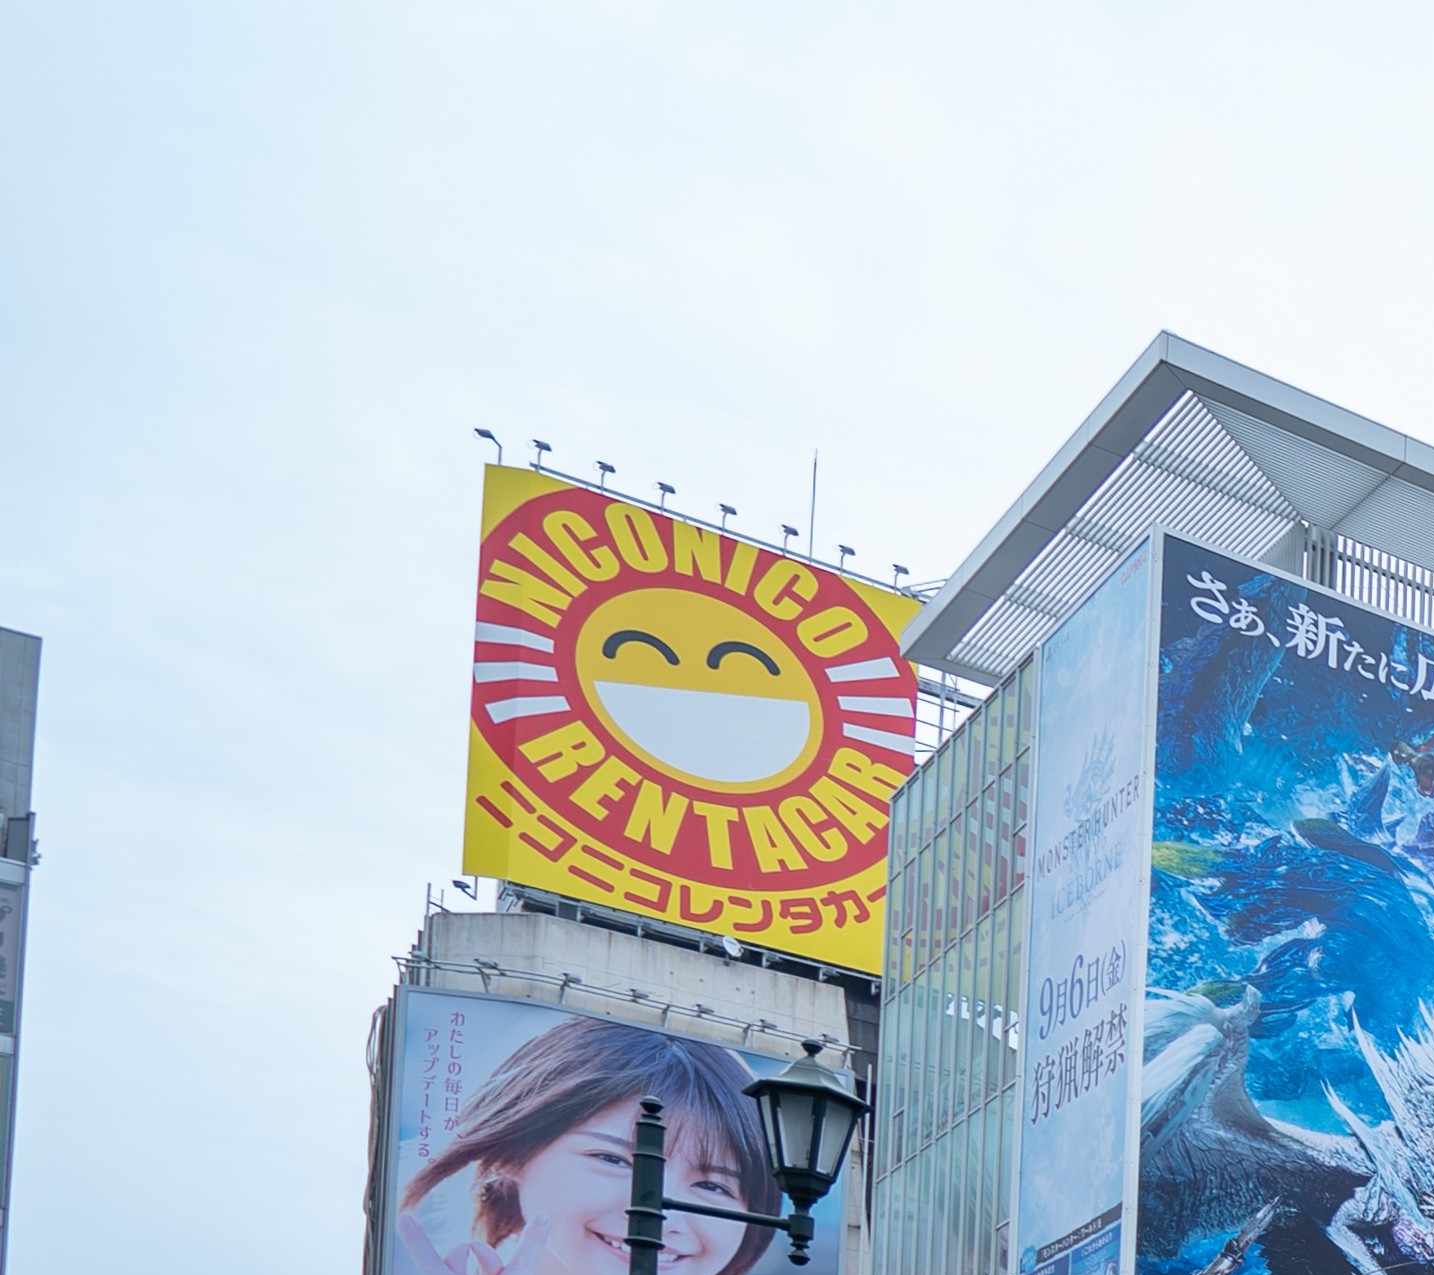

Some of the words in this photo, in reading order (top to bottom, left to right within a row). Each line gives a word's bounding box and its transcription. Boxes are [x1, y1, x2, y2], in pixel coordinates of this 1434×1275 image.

[480, 503, 868, 658] NICONICO
[518, 718, 906, 873] RENTACAR
[1037, 818, 1091, 882] MONSTER
[1094, 775, 1140, 834] HUNTER
[1051, 840, 1122, 920] ICEBORNE
[1039, 939, 1126, 1040] 9月6日(金)
[417, 1028, 438, 1166] アップデートする。
[443, 1012, 467, 1138] わたしの毎日が、
[1031, 1003, 1127, 1125] 狩猟解禁
